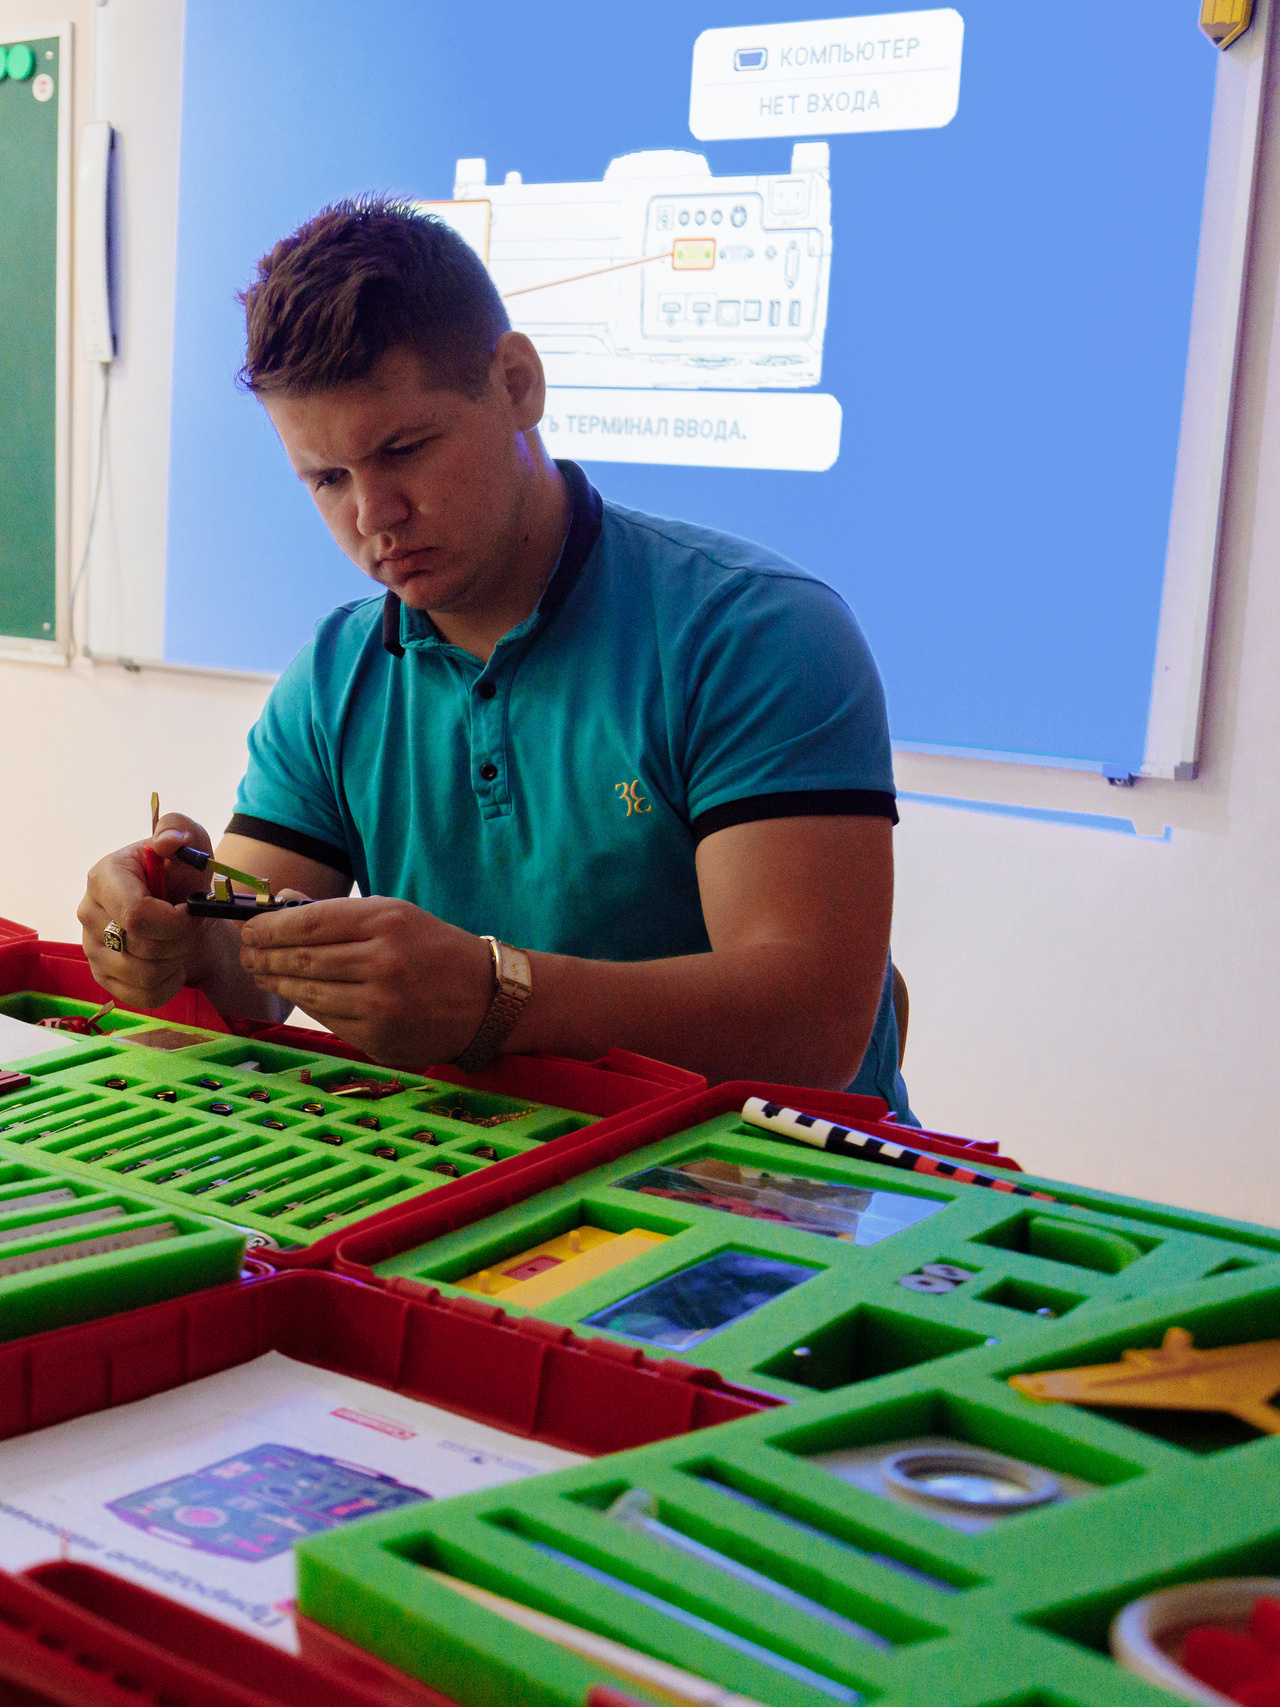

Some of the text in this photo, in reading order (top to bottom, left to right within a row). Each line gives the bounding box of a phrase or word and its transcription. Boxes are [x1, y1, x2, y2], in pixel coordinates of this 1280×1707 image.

[780, 37, 920, 68] КОМПЬЮТЕР
[759, 89, 881, 116] НЕТ ВХОДА
[565, 413, 669, 437] ТЕРМИНАЛ
[673, 417, 747, 442] ВВОДА.
